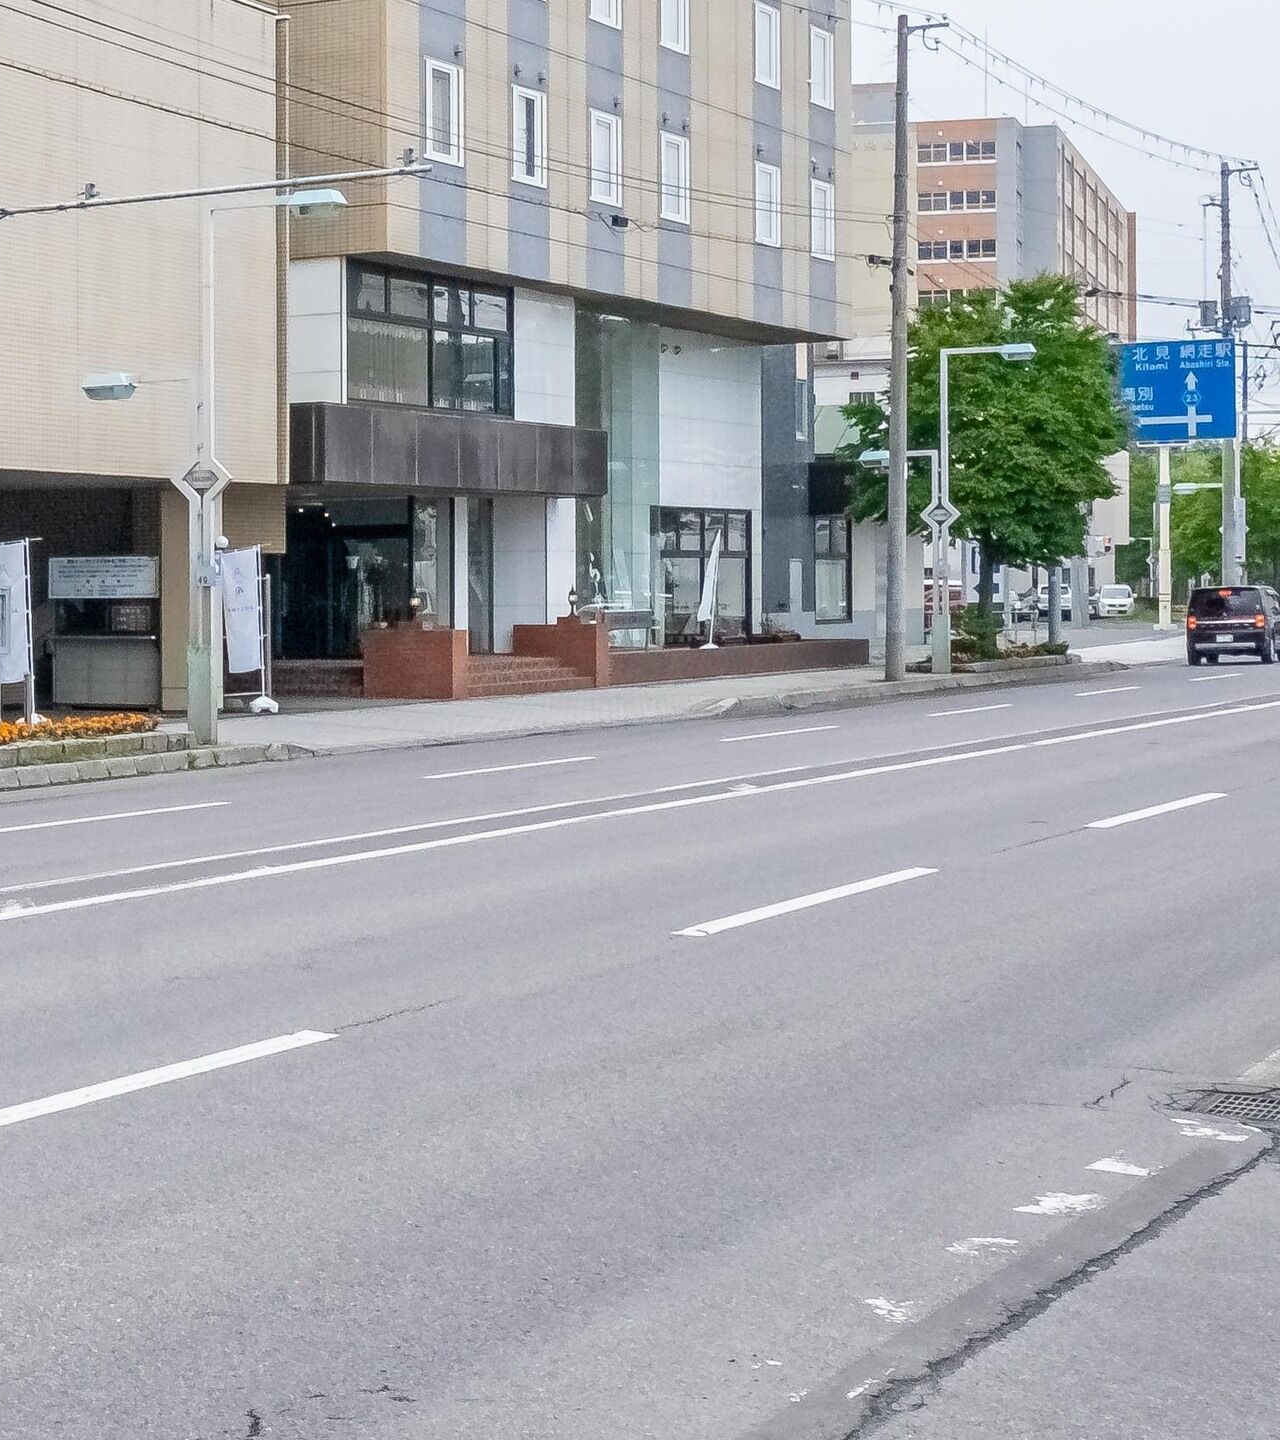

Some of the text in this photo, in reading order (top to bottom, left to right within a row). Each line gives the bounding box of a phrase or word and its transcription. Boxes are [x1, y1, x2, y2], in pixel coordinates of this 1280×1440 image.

[1132, 342, 1232, 361] 北見 網走駅
[1135, 362, 1169, 371] Kitami
[1179, 359, 1214, 369] Abashiri
